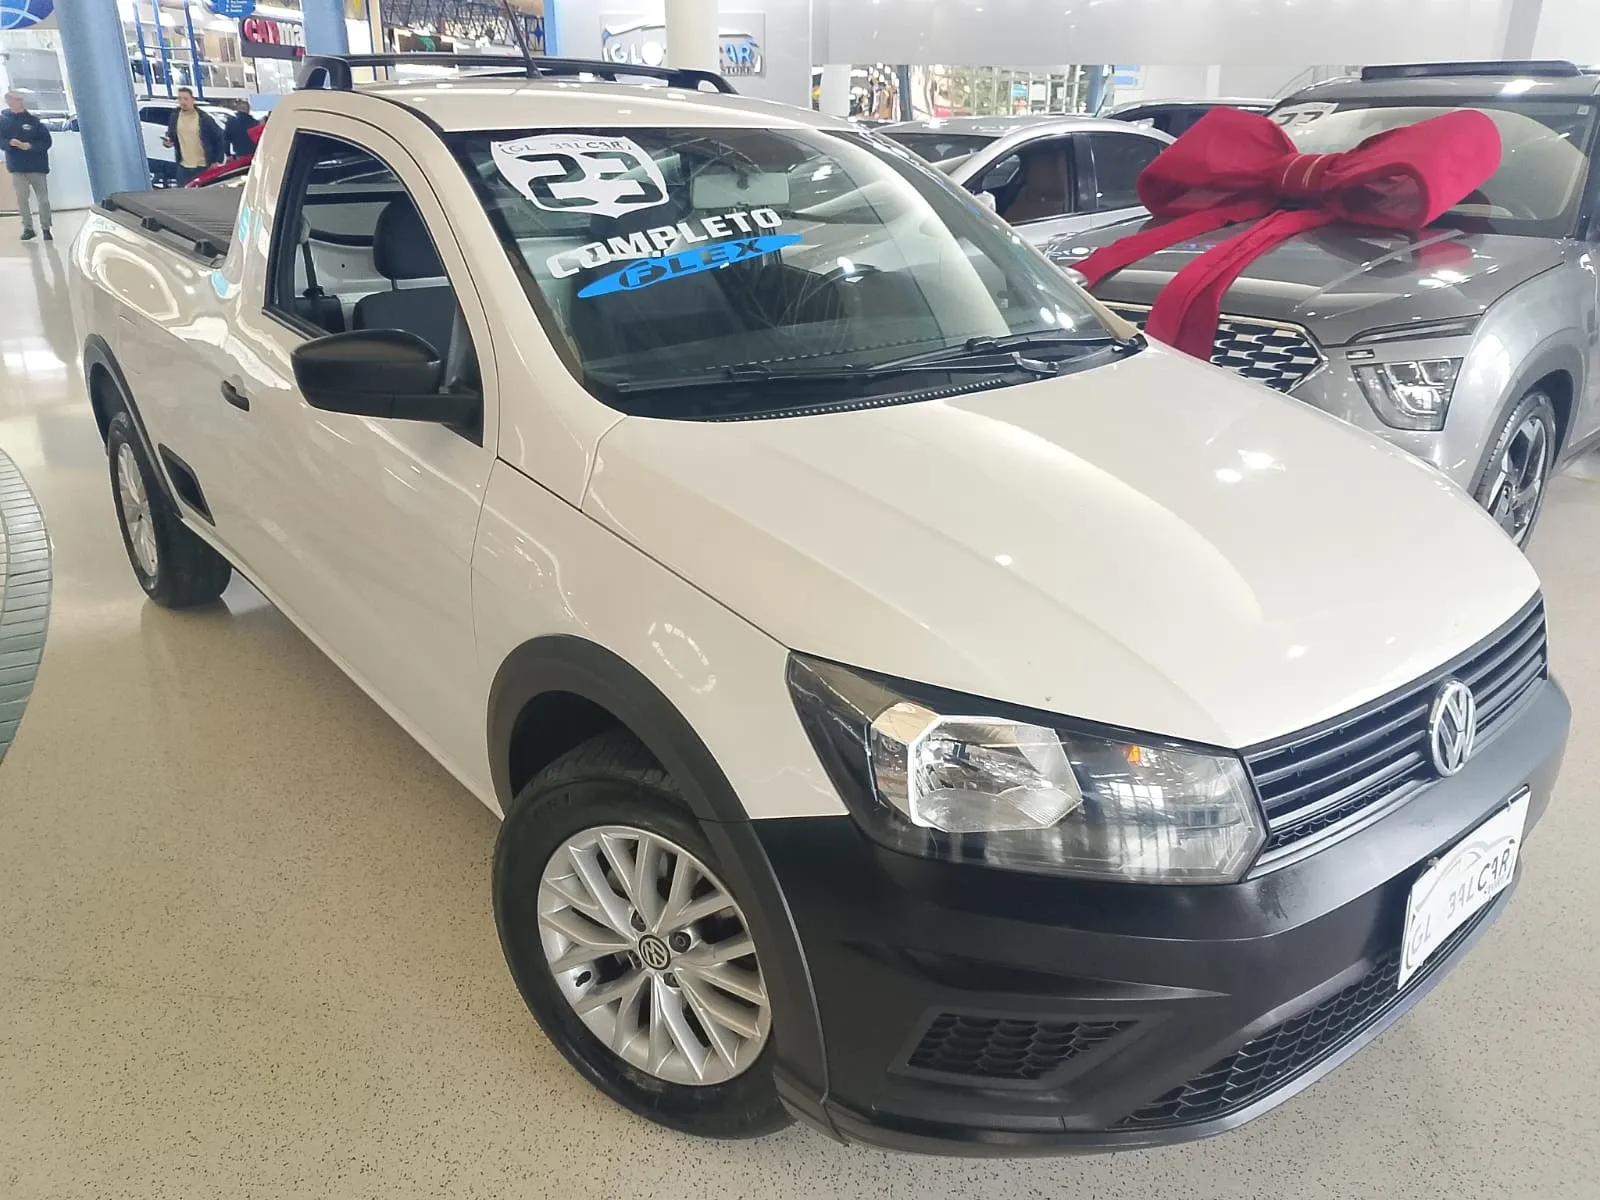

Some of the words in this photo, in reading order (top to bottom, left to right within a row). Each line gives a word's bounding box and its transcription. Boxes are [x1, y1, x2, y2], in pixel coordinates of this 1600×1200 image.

[515, 151, 664, 209] 23
[545, 207, 783, 280] COMPLETO
[622, 237, 763, 289] FLEX
